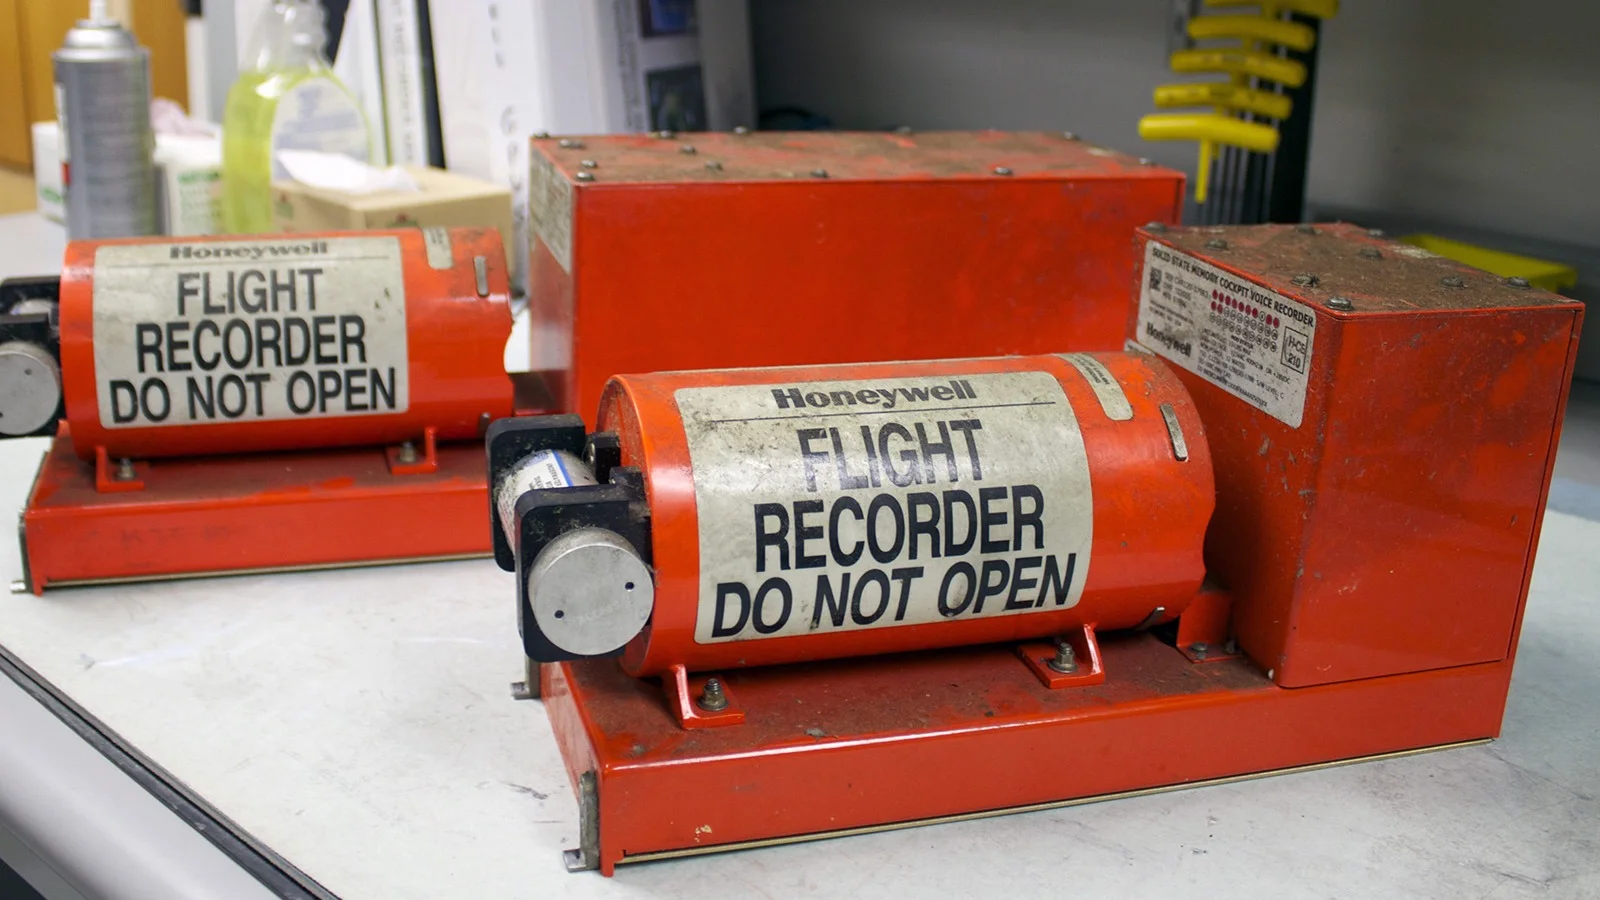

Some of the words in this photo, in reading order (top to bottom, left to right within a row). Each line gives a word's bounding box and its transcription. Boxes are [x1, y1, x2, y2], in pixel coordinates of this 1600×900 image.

[170, 241, 328, 260] Honeywell
[178, 268, 323, 316] FLIGHT
[1152, 247, 1171, 263] SOLID
[1171, 255, 1190, 272] STATE
[1191, 264, 1218, 284] MEMORY
[1219, 276, 1249, 297] COCKPIT
[1250, 289, 1272, 309] VOICE
[1273, 299, 1314, 328] RECORDER
[136, 314, 367, 374] RECORDER
[1146, 322, 1192, 357] Honeywell
[1287, 352, 1301, 369] 210
[1288, 334, 1306, 355] H-CE
[109, 378, 171, 425] DO
[186, 372, 271, 421] NOT
[286, 366, 397, 415] OPEN
[771, 379, 977, 410] Honeywell
[797, 419, 983, 492] FLIGHT
[754, 484, 1045, 573] RECORDER
[711, 576, 793, 639] DO
[810, 566, 924, 631] NOT
[937, 553, 1077, 618] OPEN
